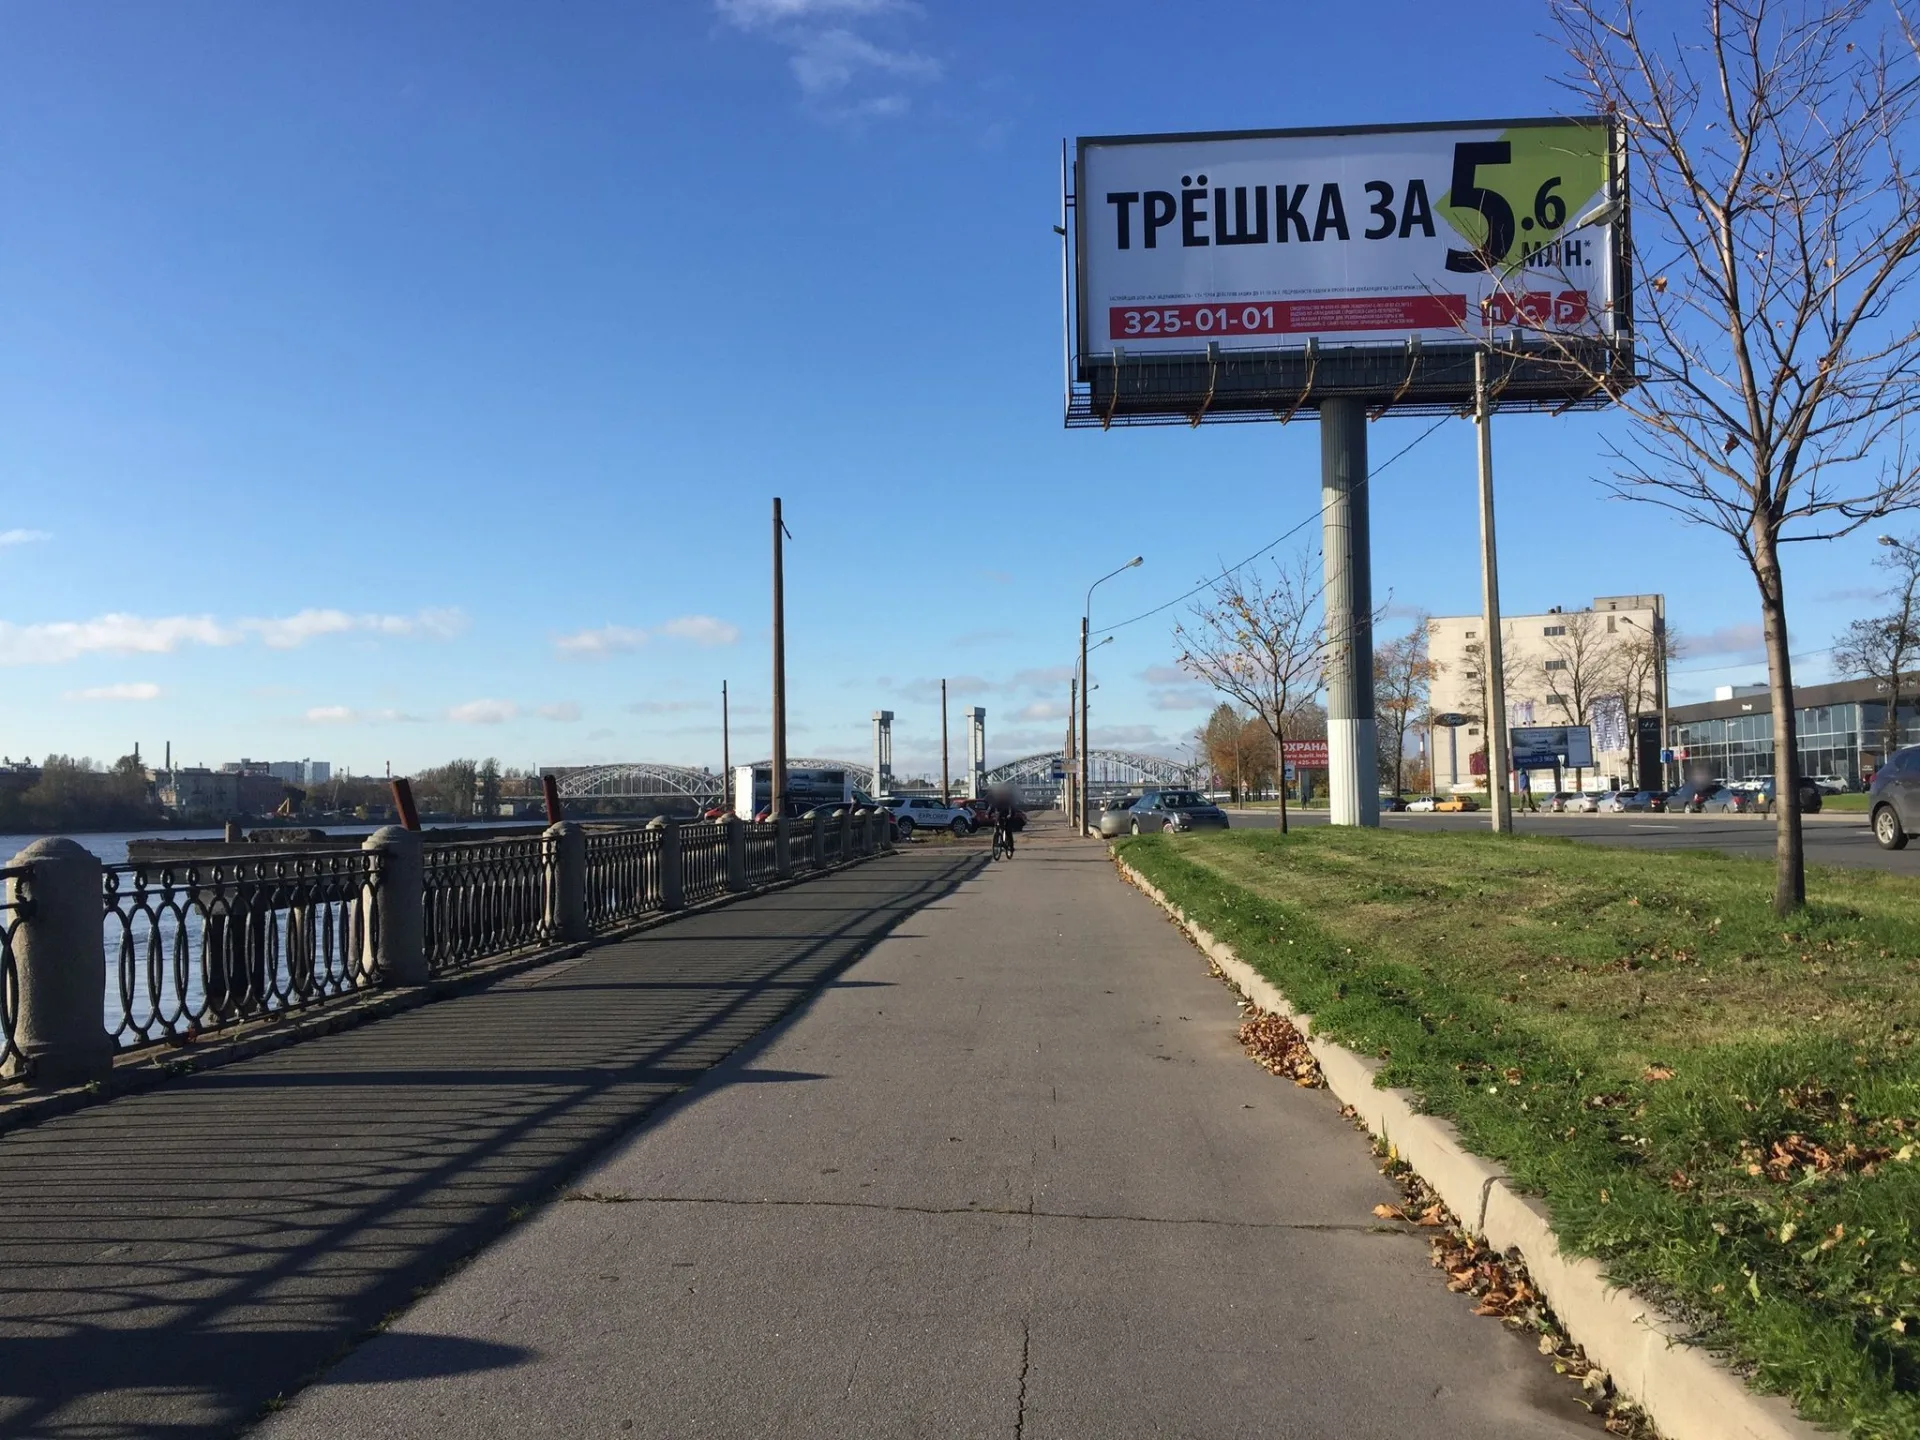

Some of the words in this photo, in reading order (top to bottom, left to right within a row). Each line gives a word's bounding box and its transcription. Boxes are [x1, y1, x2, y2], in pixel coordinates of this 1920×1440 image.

[1106, 174, 1351, 250] ТРЁШКА
[1363, 179, 1437, 240] ЗА
[1123, 305, 1277, 336] 325-01-01
